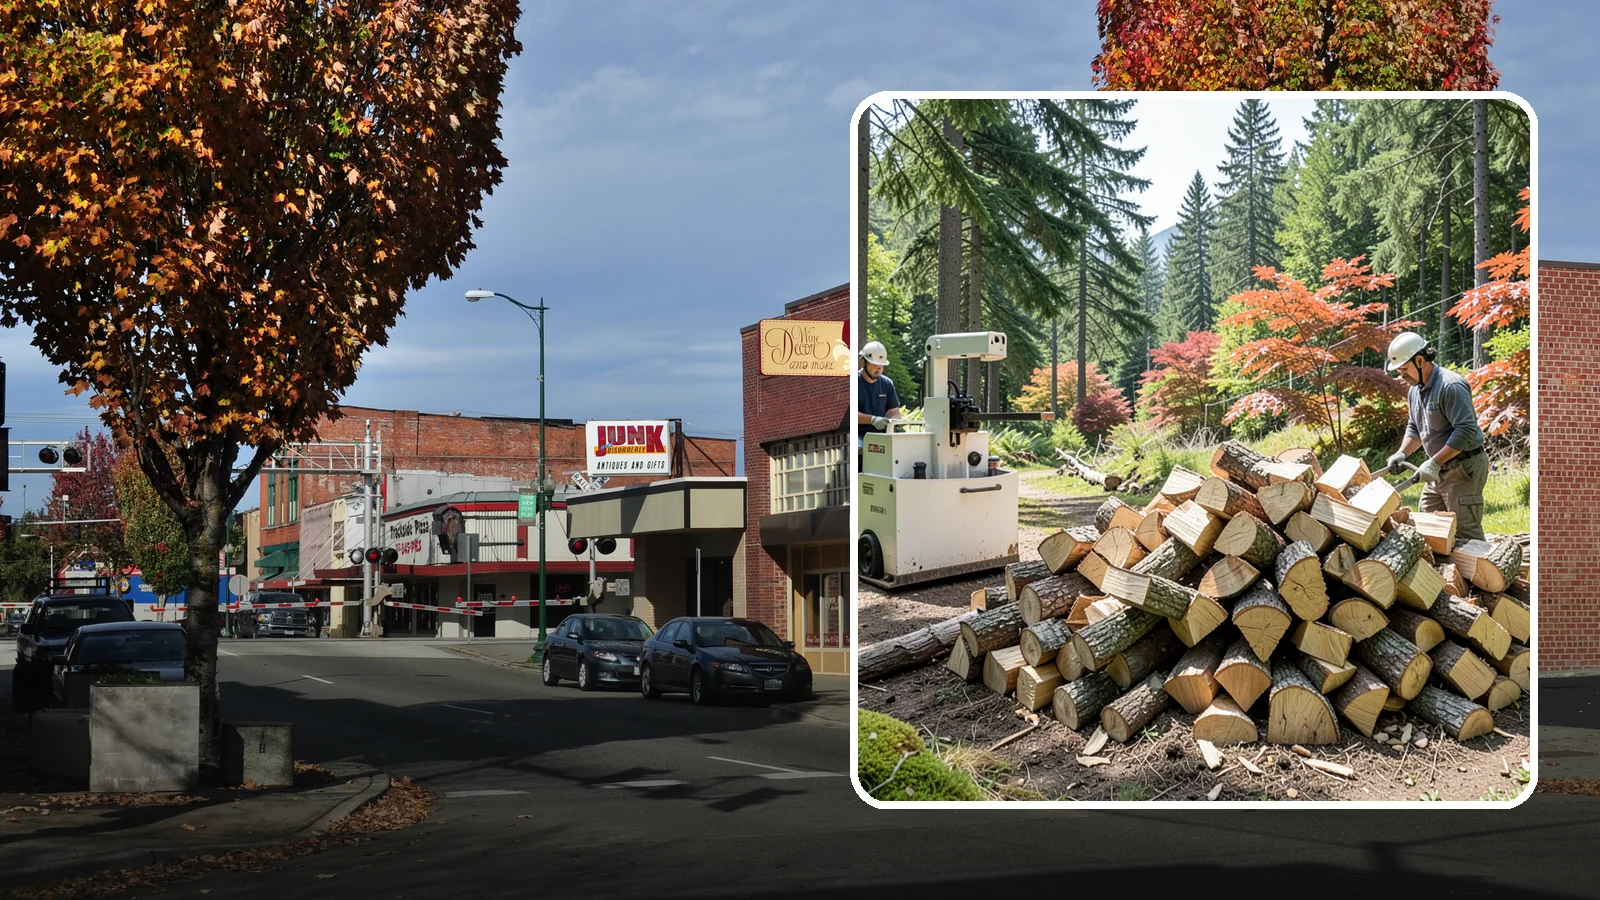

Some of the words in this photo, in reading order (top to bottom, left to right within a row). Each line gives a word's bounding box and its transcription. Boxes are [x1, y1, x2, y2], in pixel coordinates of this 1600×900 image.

[765, 327, 831, 365] Decor
[596, 425, 665, 457] JUNK
[597, 461, 628, 470] ANTIQUES
[631, 461, 644, 470] AND
[647, 460, 665, 470] GIFTS
[573, 473, 589, 491] RAIL
[414, 519, 429, 535] Pizza
